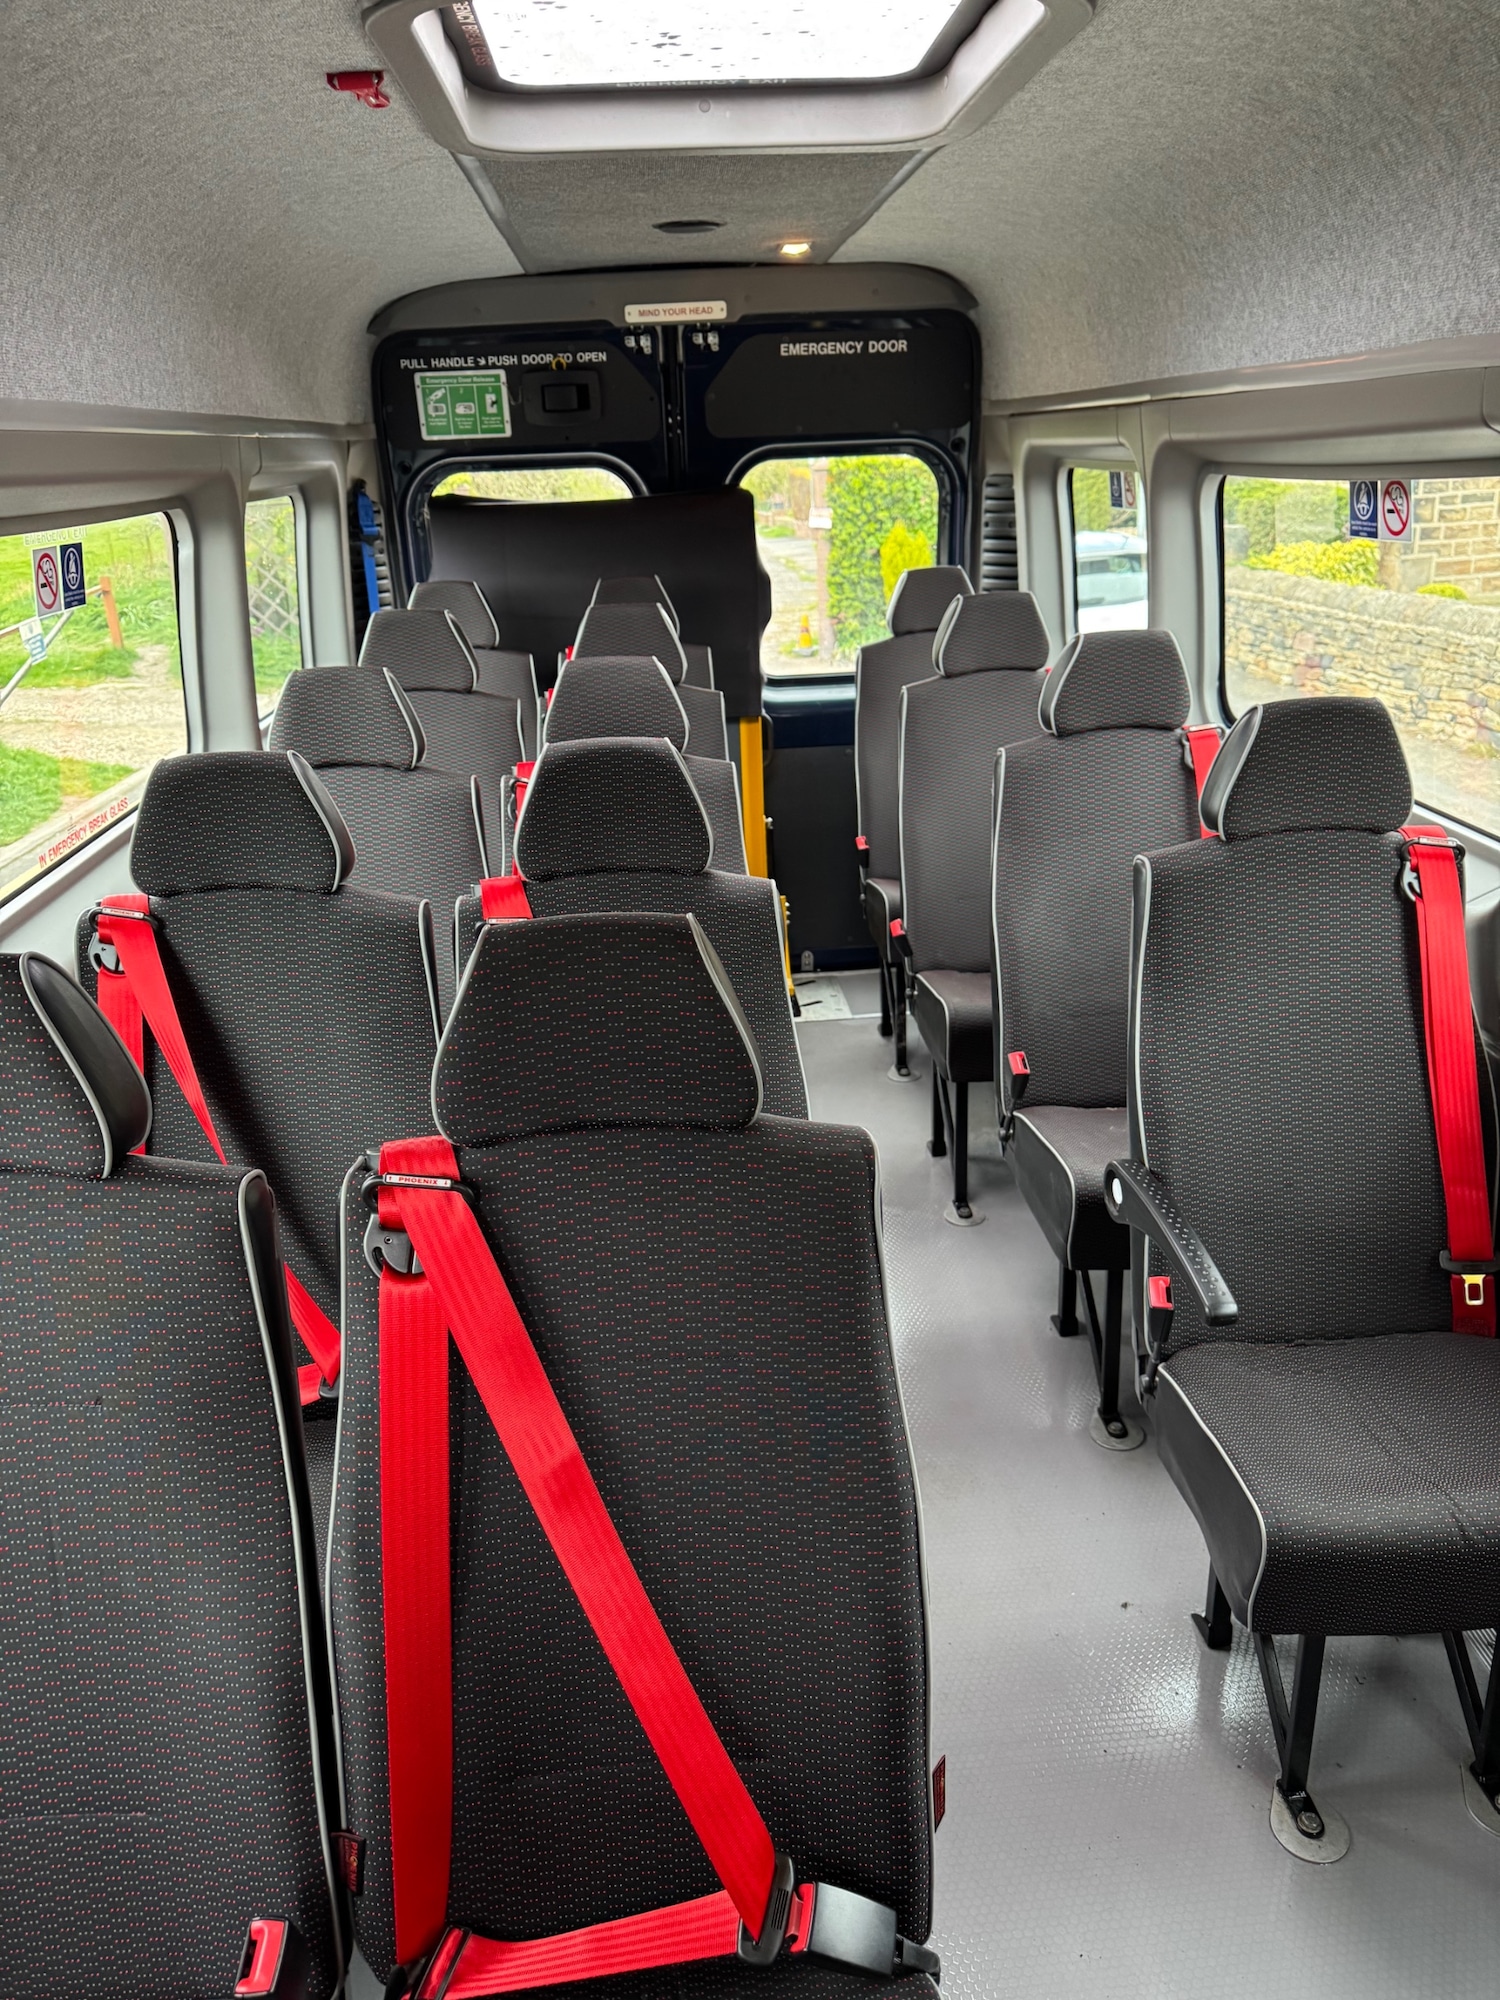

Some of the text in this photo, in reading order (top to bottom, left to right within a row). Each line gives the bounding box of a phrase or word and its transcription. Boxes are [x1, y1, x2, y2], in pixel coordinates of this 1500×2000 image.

[616, 79, 739, 88] EMERGENCY
[638, 306, 714, 317] MIND YOUR HEAD
[780, 340, 908, 356] EMERGENCY DOOR
[400, 358, 428, 369] PULL
[430, 356, 475, 368] HANDLE
[487, 355, 518, 366] PUSH
[521, 353, 554, 365] DOOR
[576, 351, 607, 363] OPEN
[426, 377, 457, 385] Emergency
[38, 853, 47, 869] IN
[48, 824, 87, 862] EMERGENCY
[88, 810, 109, 833] BREAK
[110, 797, 128, 818] GLASS
[398, 1176, 438, 1185] PHOENIX
